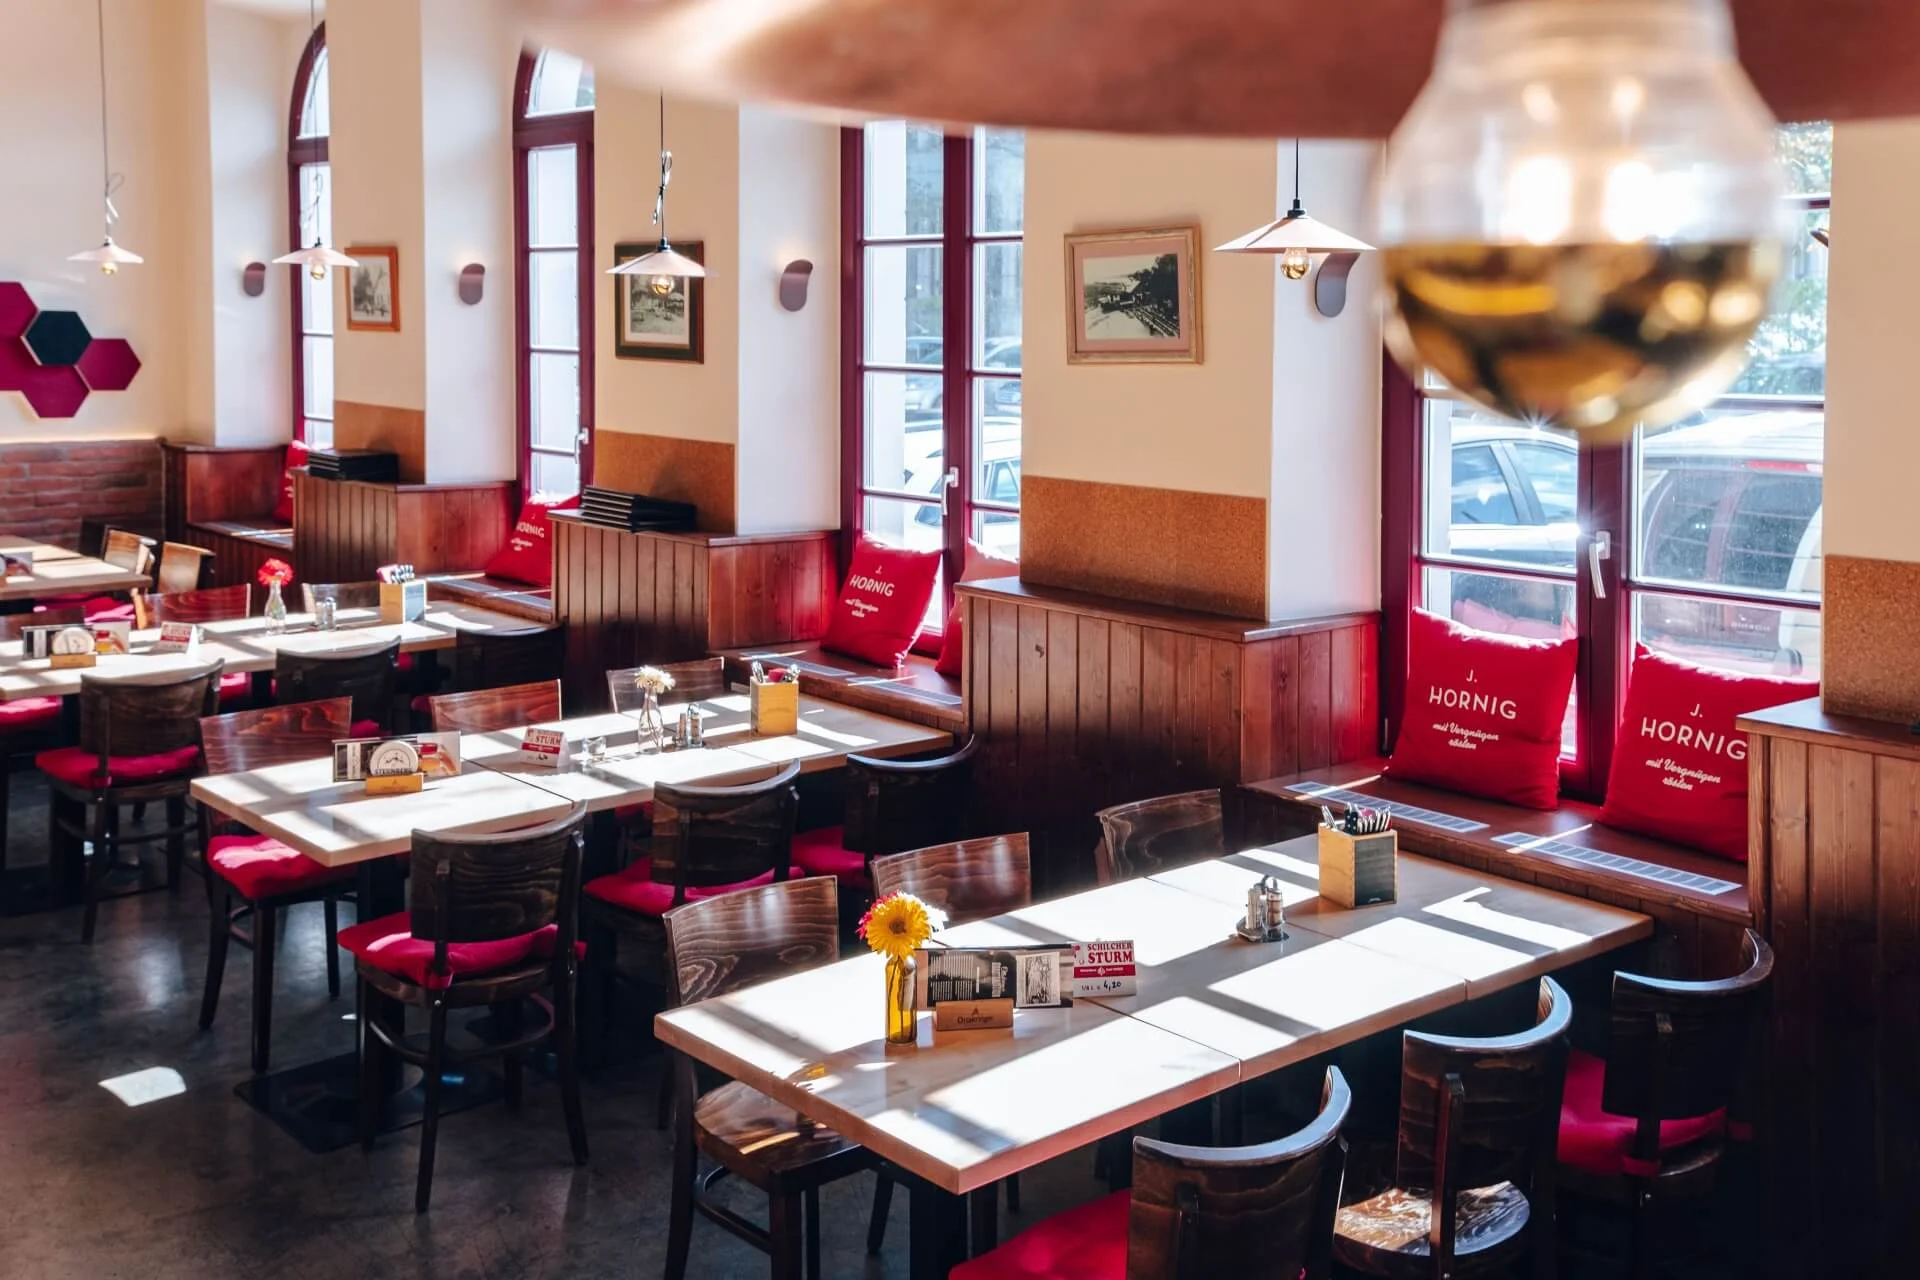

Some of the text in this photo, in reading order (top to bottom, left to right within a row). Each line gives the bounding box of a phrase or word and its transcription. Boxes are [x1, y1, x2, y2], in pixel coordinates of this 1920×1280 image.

[849, 574, 895, 597] HORNIG
[1466, 669, 1477, 683] J.
[1429, 685, 1517, 719] HORNIG
[1690, 703, 1703, 718] J.
[1641, 716, 1748, 760] HORNIG
[1088, 942, 1132, 951] SCHILCHER
[1088, 951, 1133, 963] STURM
